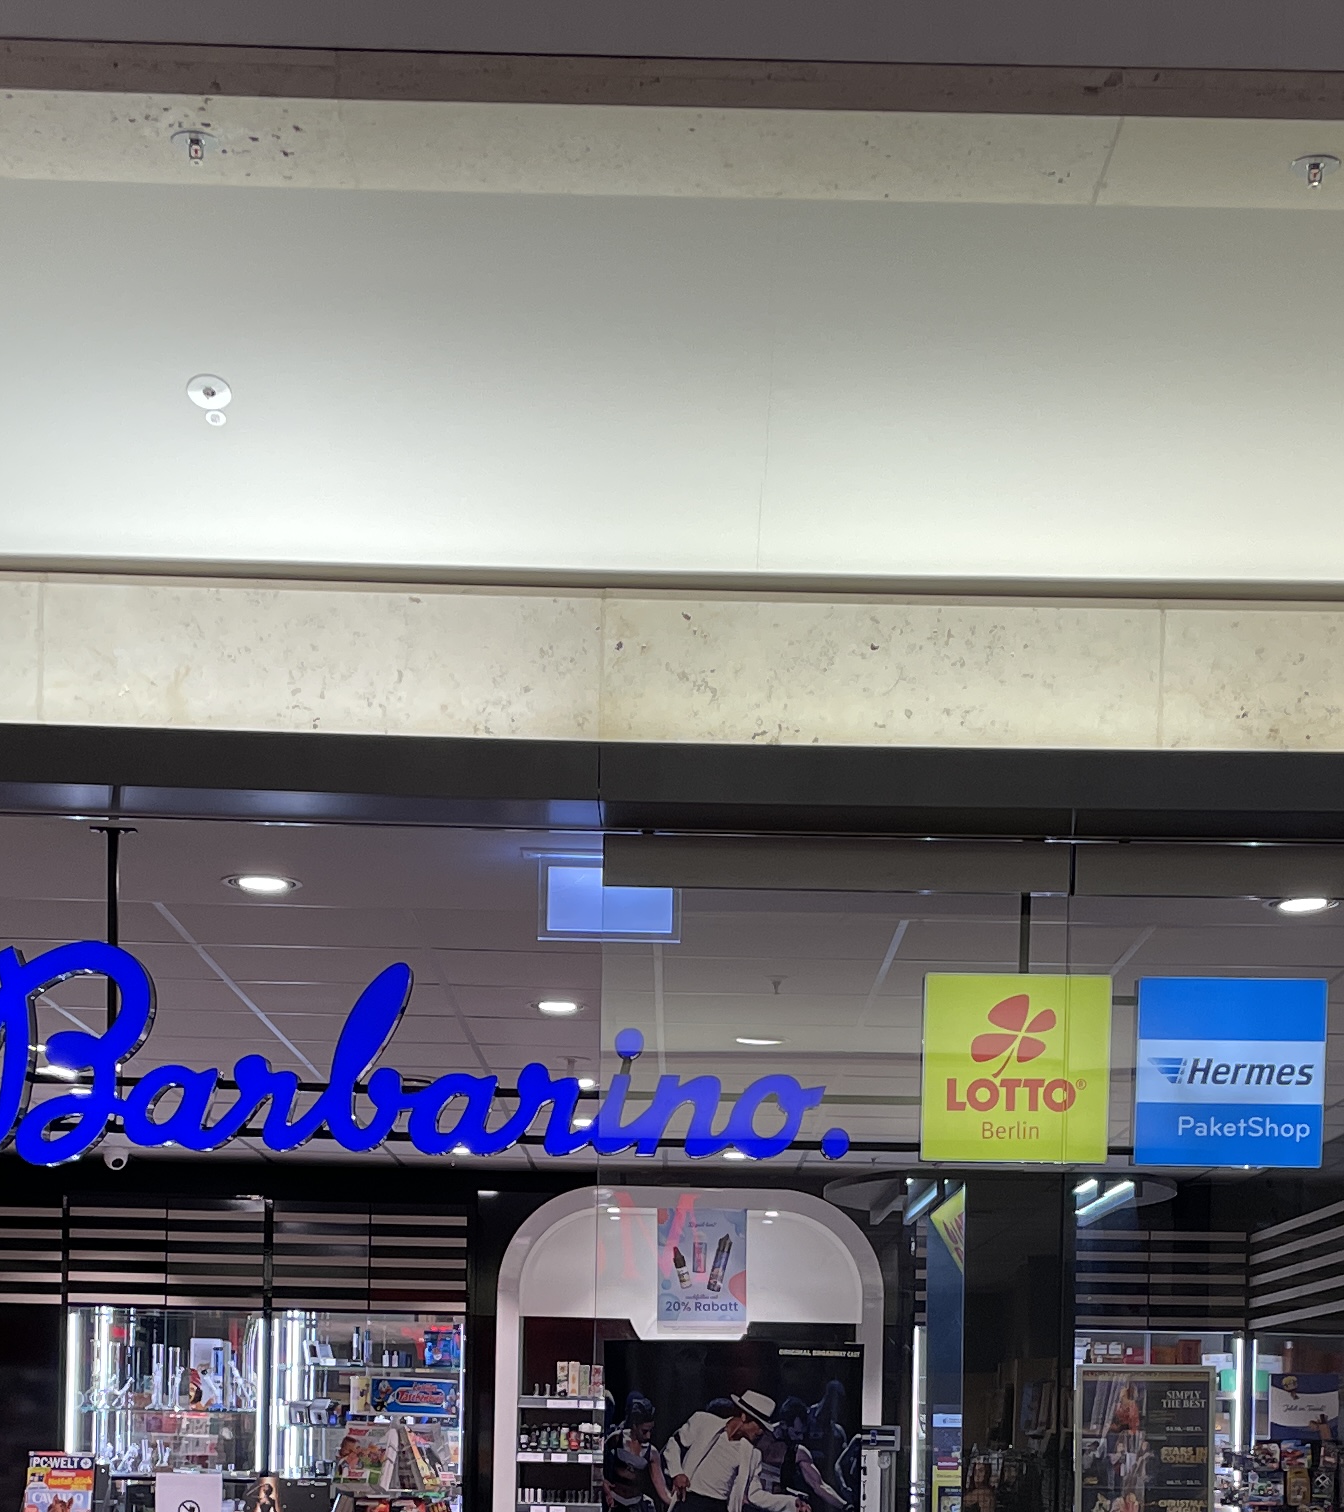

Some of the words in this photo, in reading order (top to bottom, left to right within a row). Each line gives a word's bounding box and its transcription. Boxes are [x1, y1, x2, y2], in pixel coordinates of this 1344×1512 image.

[1186, 1057, 1315, 1088] Hermes
[981, 1121, 1041, 1141] Berlin
[1177, 1116, 1311, 1143] PaketShop
[665, 1301, 692, 1312] 20%
[694, 1301, 739, 1312] Rabatt
[1166, 1390, 1202, 1400] SIMPLY
[1161, 1399, 1182, 1408] THE
[1182, 1399, 1207, 1409] BEST
